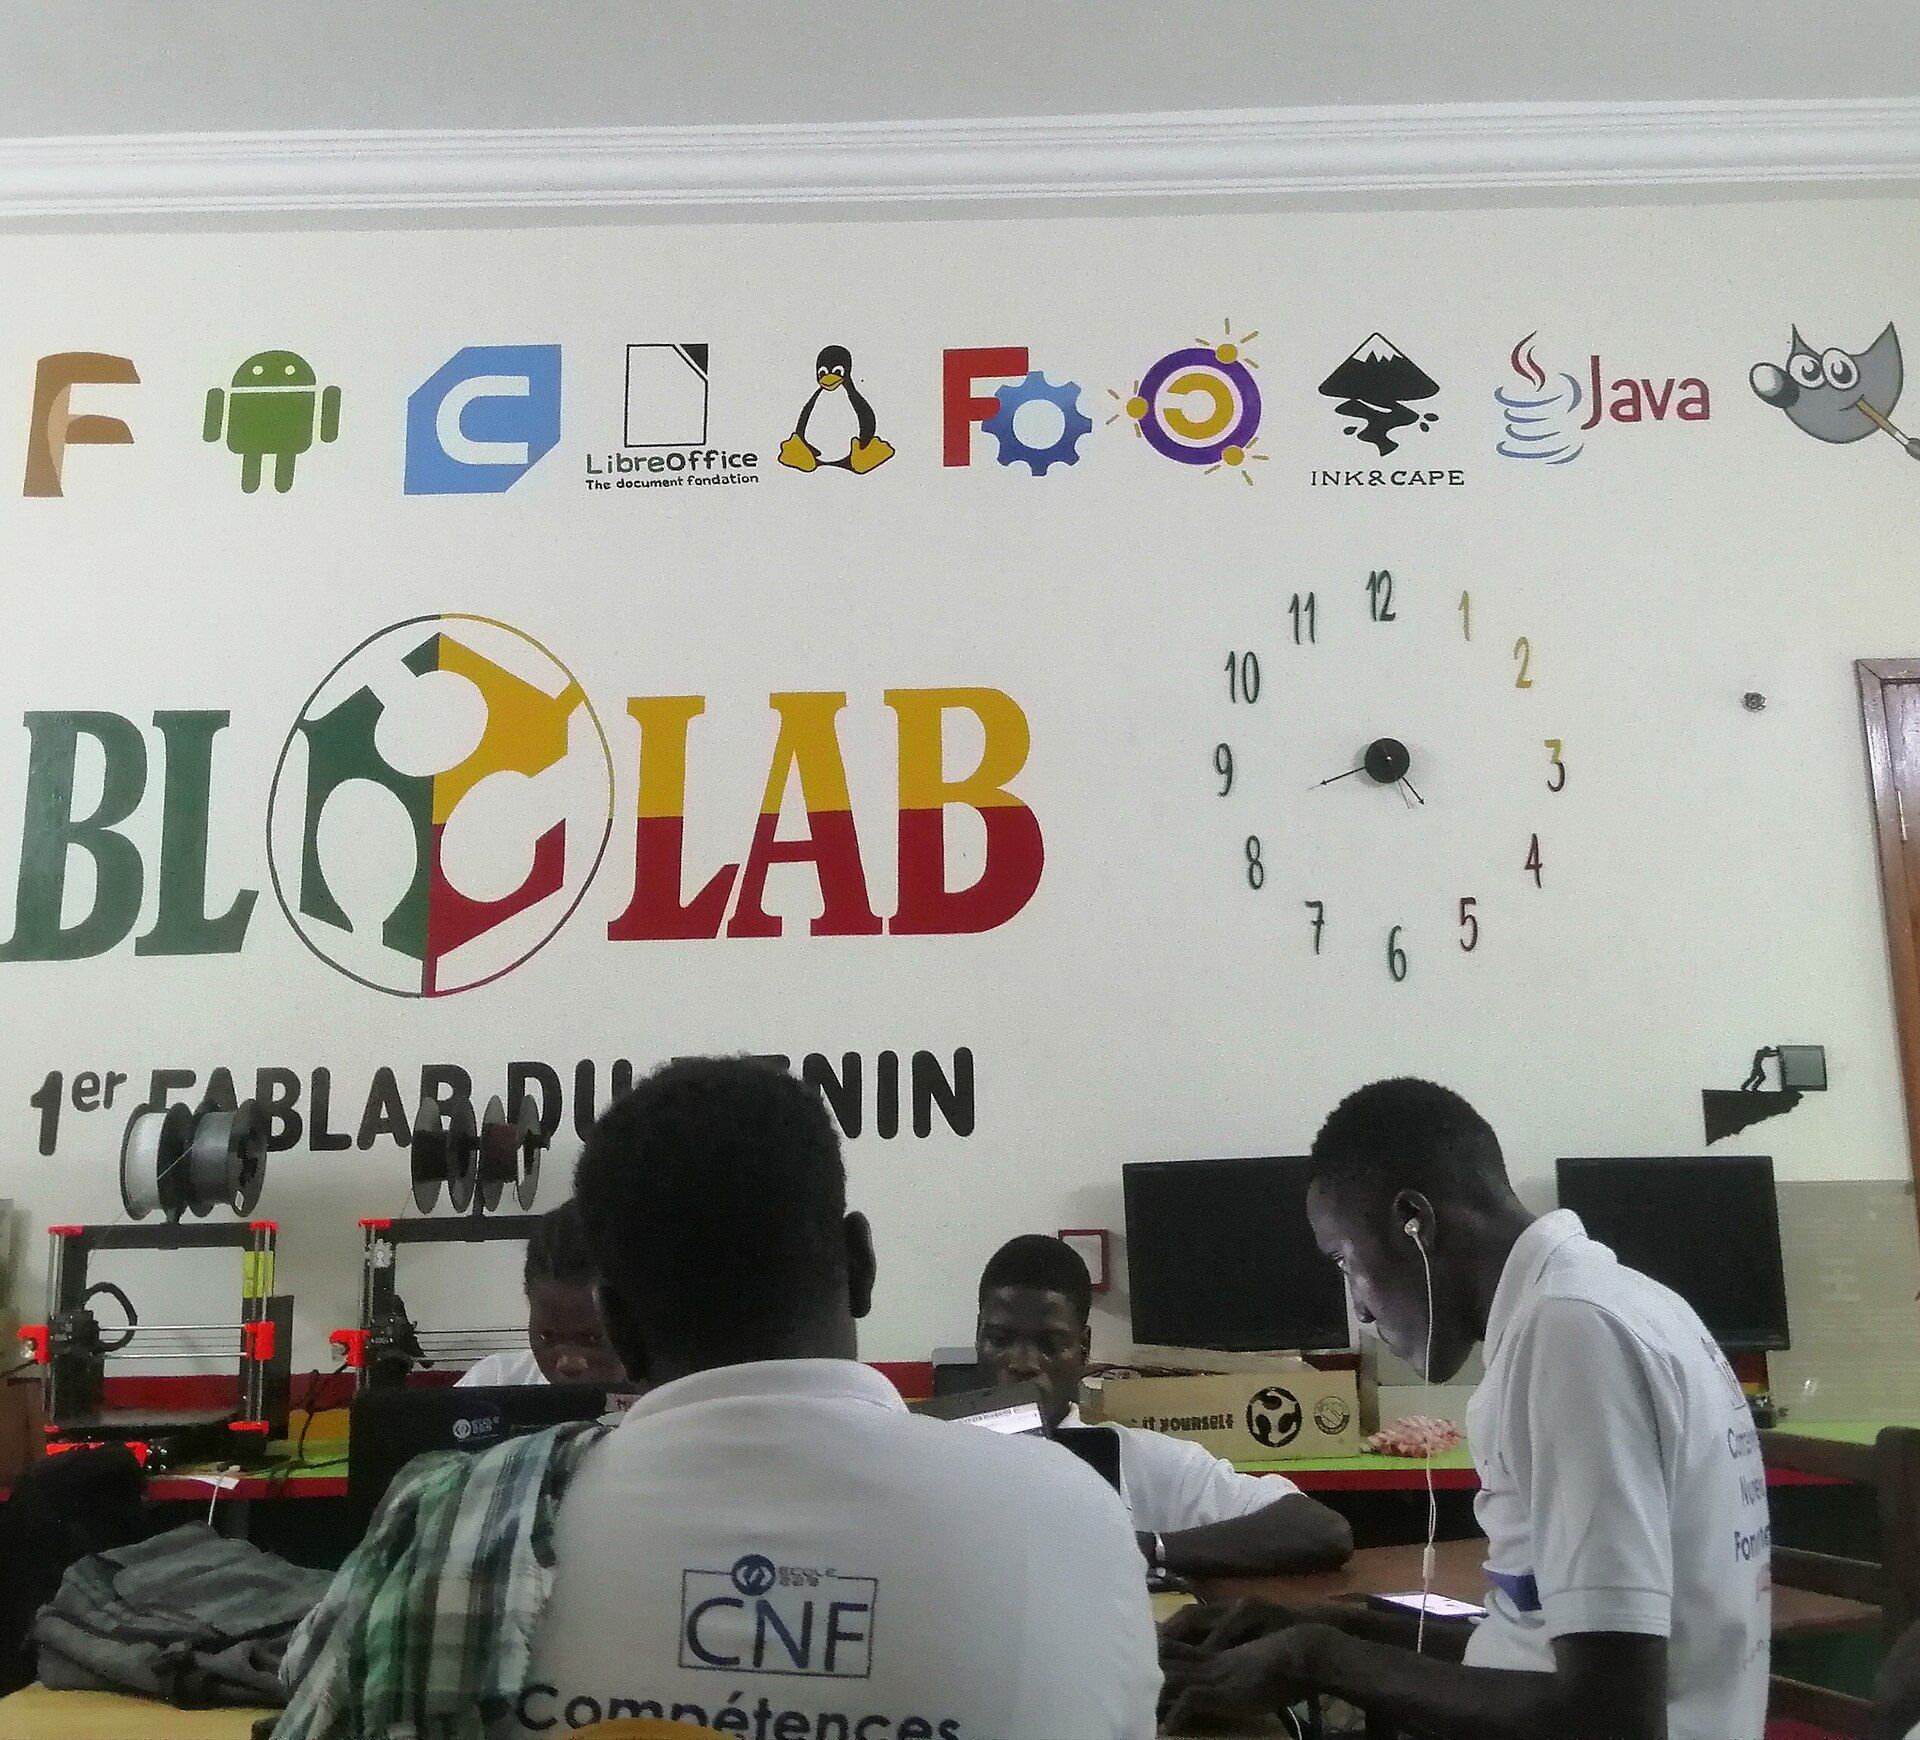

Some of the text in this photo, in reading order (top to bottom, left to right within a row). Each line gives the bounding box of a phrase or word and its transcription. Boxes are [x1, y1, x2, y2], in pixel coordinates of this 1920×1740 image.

[1580, 354, 1710, 430] Java
[585, 473, 759, 490] The document fondation
[586, 450, 758, 475] LibreOffice
[1288, 592, 1315, 645] 11
[1366, 570, 1396, 622] 12
[1459, 591, 1471, 641] 1
[1224, 650, 1260, 704] 10
[1514, 636, 1533, 688] 2
[1214, 742, 1234, 797] 9
[1544, 739, 1566, 792] 3
[1246, 835, 1264, 890] 8
[1524, 833, 1543, 888] 4
[1304, 900, 1325, 955] 7
[1459, 896, 1479, 952] 5
[1388, 925, 1407, 982] 6
[30, 1069, 127, 1156] 1er
[687, 1596, 868, 1672] CNF
